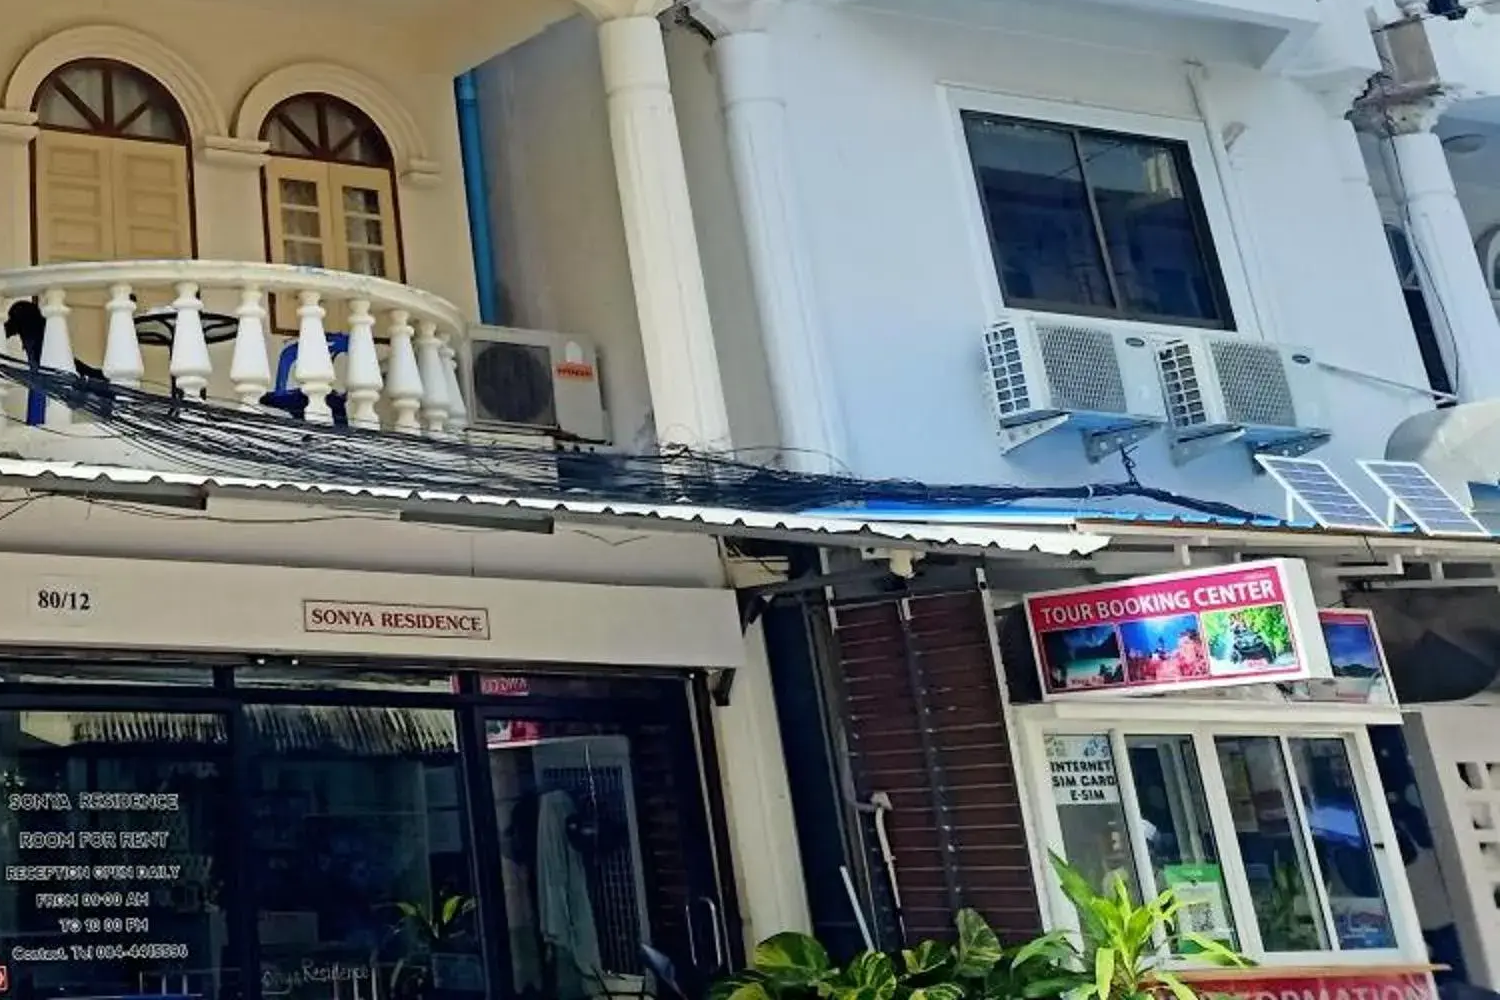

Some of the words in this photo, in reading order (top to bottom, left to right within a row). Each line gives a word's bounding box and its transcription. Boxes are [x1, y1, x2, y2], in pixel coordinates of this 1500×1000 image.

[37, 589, 90, 611] 80/12
[1040, 602, 1093, 624] TOUR
[1098, 590, 1190, 619] BOOKING
[1194, 579, 1276, 606] CENTER
[311, 607, 375, 628] SONYA
[380, 610, 483, 633] RESIDENCE
[1050, 761, 1111, 772] INTERNET
[1051, 776, 1077, 787] SIM
[1081, 776, 1115, 787] CARD
[8, 793, 72, 811] SONYA
[79, 792, 179, 811] RESIDENCE
[1070, 789, 1105, 801] E-SIM
[19, 831, 75, 849] ROOM
[78, 831, 117, 849] FOR
[119, 831, 170, 849] RENT
[5, 865, 90, 881] RECEPTION
[92, 865, 134, 880] OPEN
[135, 865, 181, 880] DAILY
[35, 892, 79, 908] FROM
[125, 891, 149, 907] AM
[58, 916, 82, 933] TO
[125, 916, 149, 933] PM
